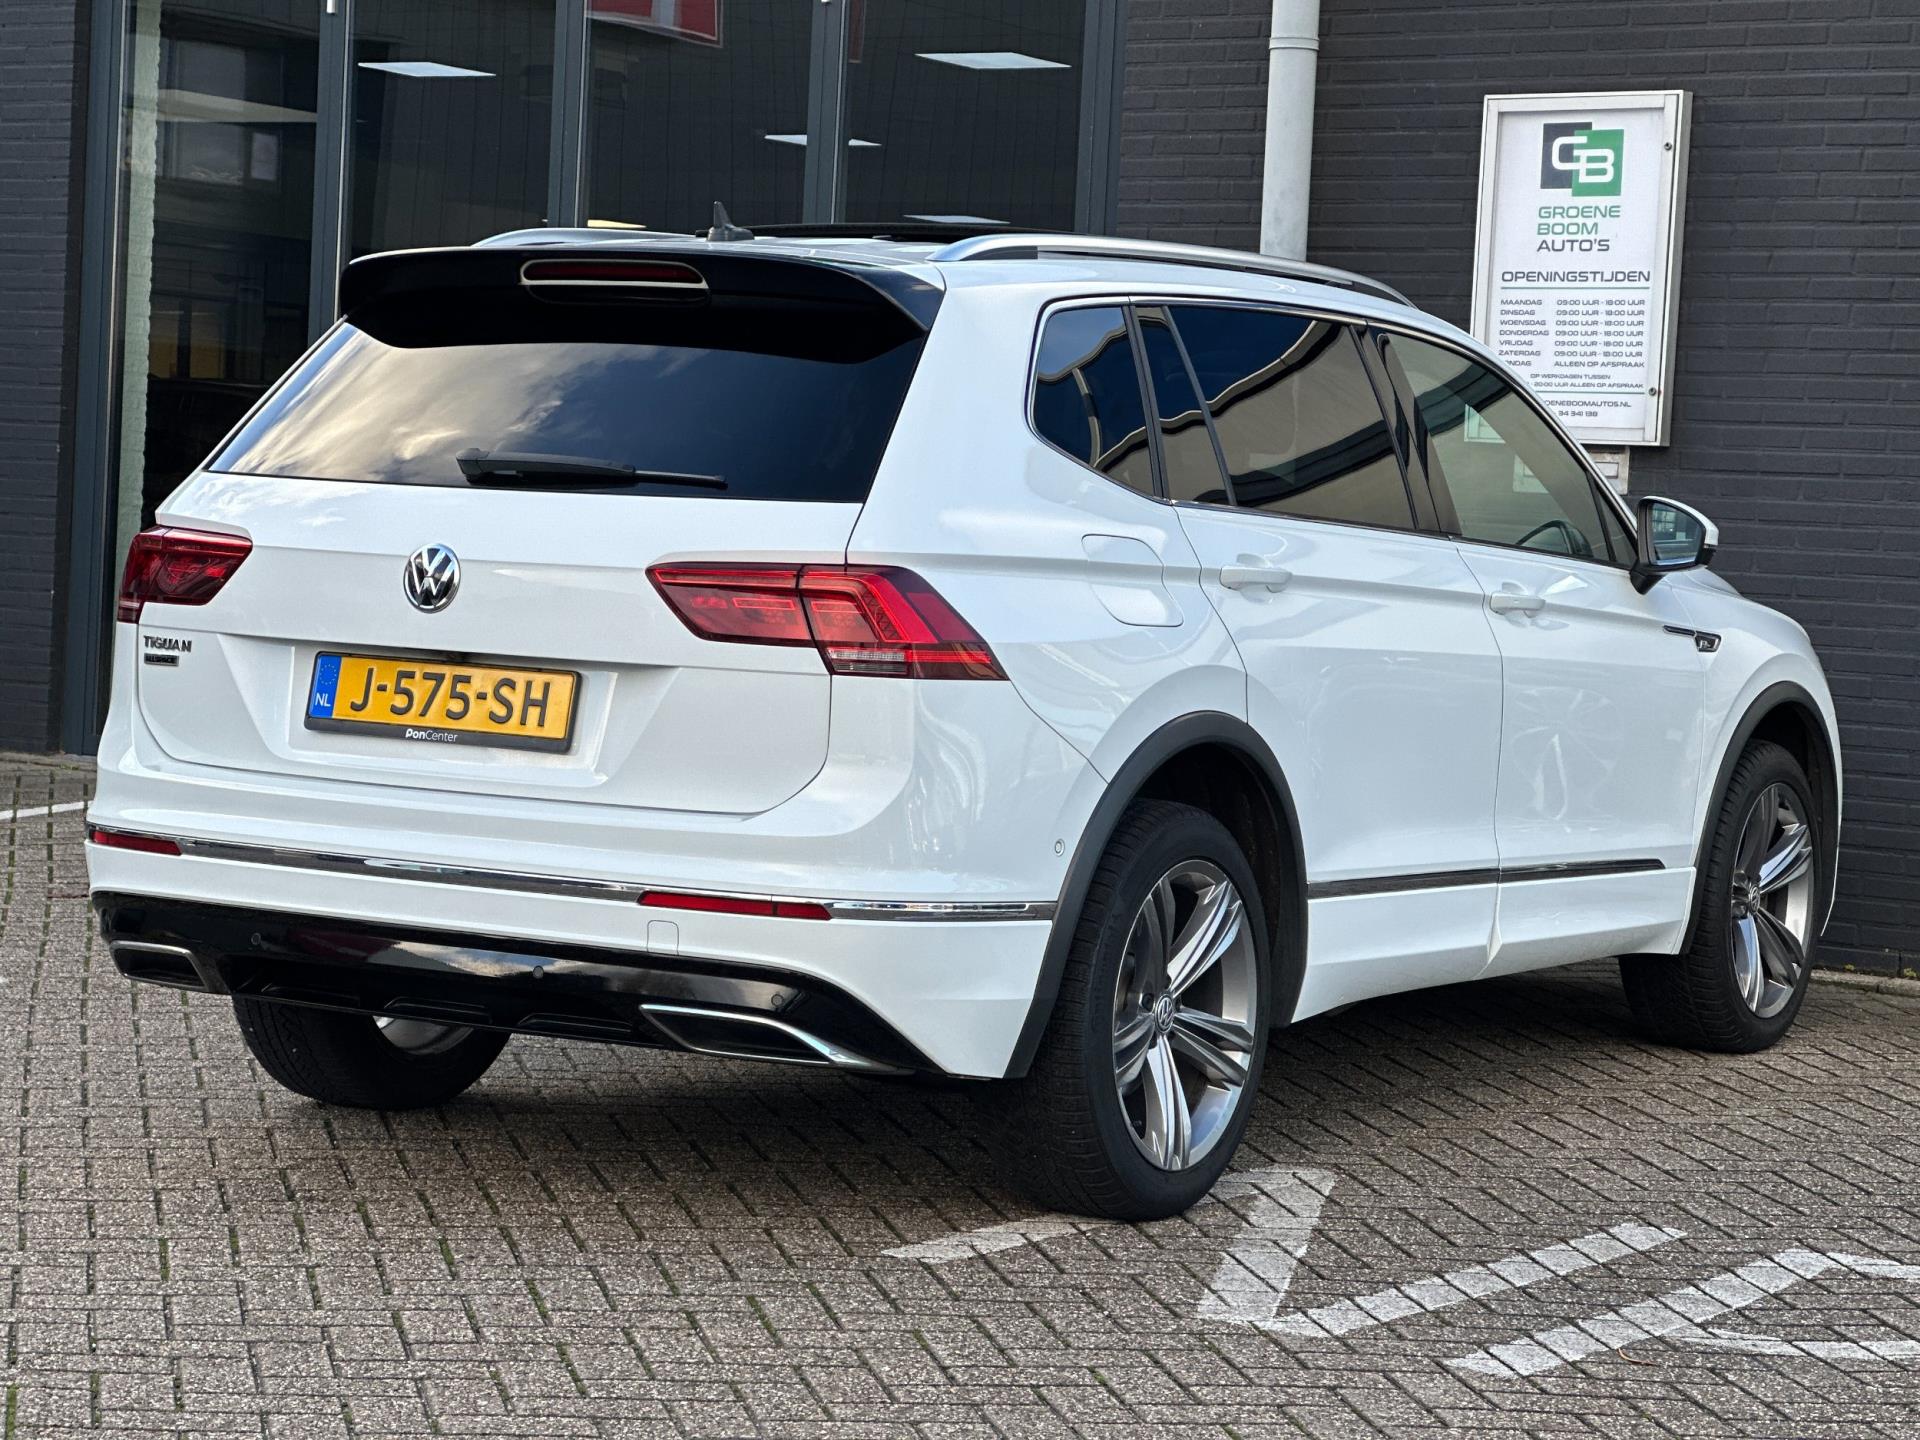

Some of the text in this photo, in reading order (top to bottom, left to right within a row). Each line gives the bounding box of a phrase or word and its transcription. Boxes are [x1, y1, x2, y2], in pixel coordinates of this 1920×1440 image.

[1538, 205, 1622, 219] GROENE
[1537, 222, 1599, 236] BOOM
[1537, 238, 1610, 252] AUTO'S
[1501, 270, 1651, 282] OPENINGSTIJDEN
[1544, 400, 1632, 408] OENEBOOMAUTOS.NL
[143, 635, 192, 653] TIGUAN
[315, 667, 551, 728] NL J-575-SH
[405, 728, 459, 743] PonCenter
